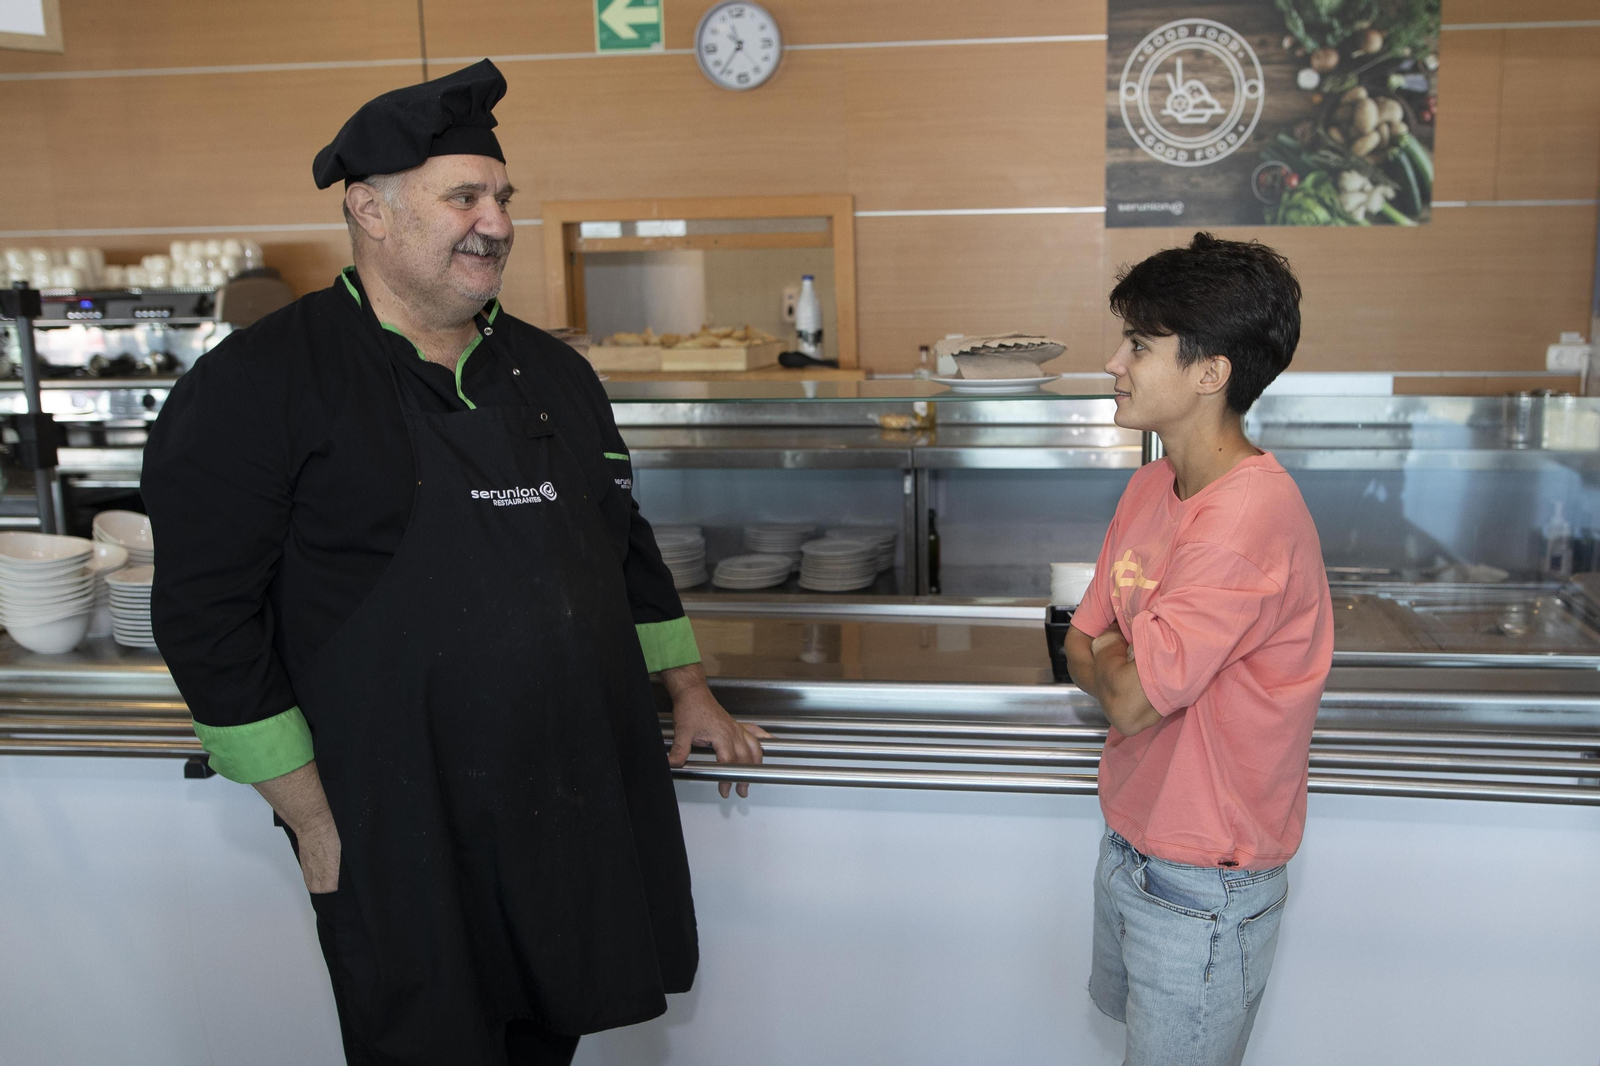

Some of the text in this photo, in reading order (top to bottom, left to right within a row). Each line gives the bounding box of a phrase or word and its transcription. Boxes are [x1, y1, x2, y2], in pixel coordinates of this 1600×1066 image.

[1143, 26, 1240, 55] GOOD FOOD
[1144, 132, 1238, 162] GOOD FOOD
[471, 486, 539, 499] serunion
[493, 496, 542, 506] RESTAURANTES
